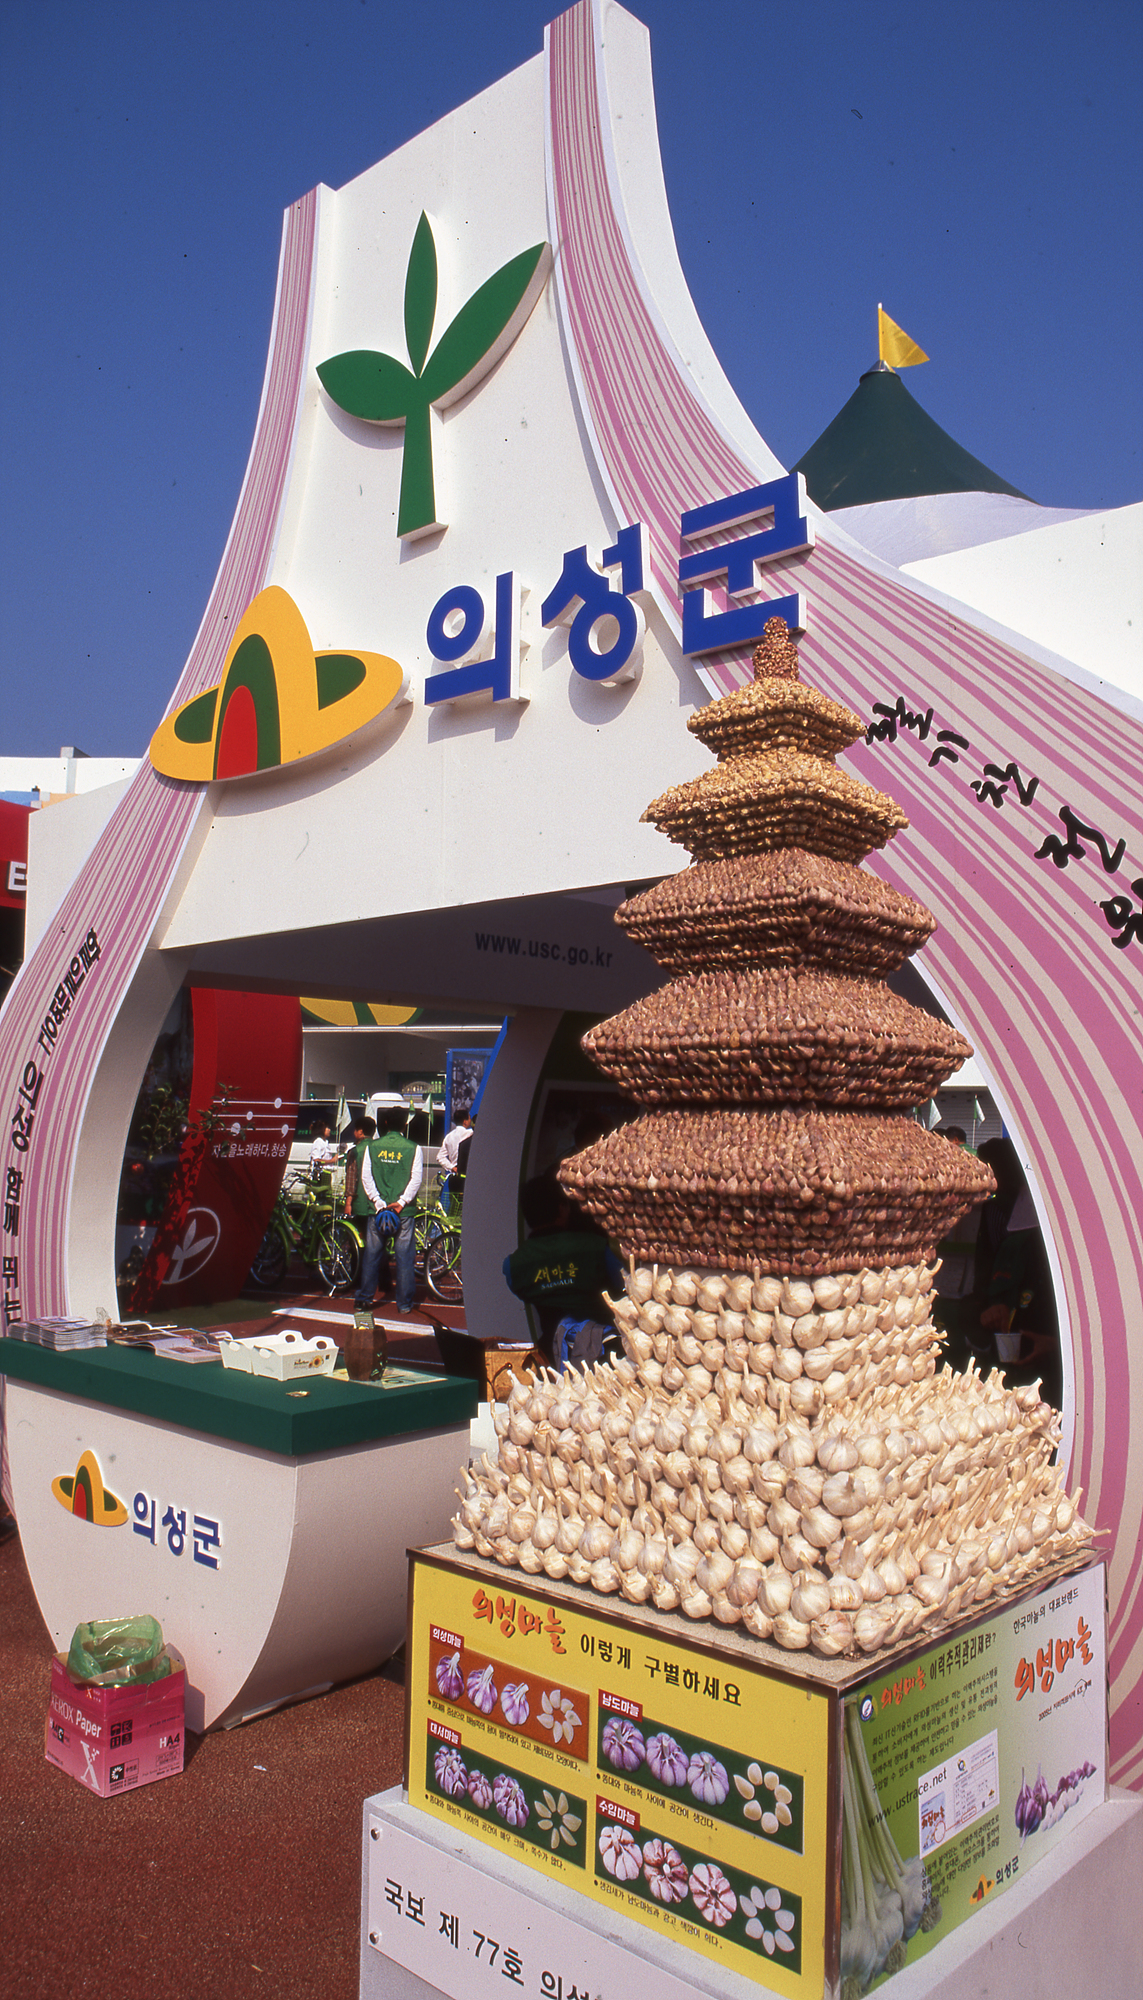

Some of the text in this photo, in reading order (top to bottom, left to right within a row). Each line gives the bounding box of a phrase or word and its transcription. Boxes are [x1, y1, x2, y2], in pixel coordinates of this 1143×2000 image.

[425, 472, 809, 707] 의성군
[866, 697, 1040, 808] 활기찬
[475, 932, 613, 968] www.usc.go.kr
[12, 1060, 45, 1153] 의성
[2, 1166, 23, 1237] 함께
[133, 1492, 222, 1570] 의성군
[1013, 1587, 1079, 1635] 한국마늘의 대표브랜드
[432, 1627, 462, 1649] 의성마늘
[472, 1588, 742, 1707] 의성마늘 이렇게 구별하세요
[1014, 1616, 1093, 1702] 의성마늘
[602, 1693, 640, 1718] 남도마늘
[881, 1666, 926, 1709] 의성마늘
[50, 1695, 74, 1723] XEROX
[76, 1709, 102, 1738] Paper
[430, 1722, 459, 1745] 대서마늘
[159, 1733, 180, 1749] HA4
[599, 1800, 636, 1826] 수입마늘
[645, 1792, 666, 1809] 사이에
[669, 1802, 689, 1819] 공간이
[693, 1812, 718, 1831] 생긴다.
[868, 1767, 947, 1829] www.ustrace.net
[995, 1855, 1019, 1884] 의성군
[383, 1877, 427, 1927] 국보
[438, 1910, 460, 1949] 제
[471, 1929, 526, 1986] 77호
